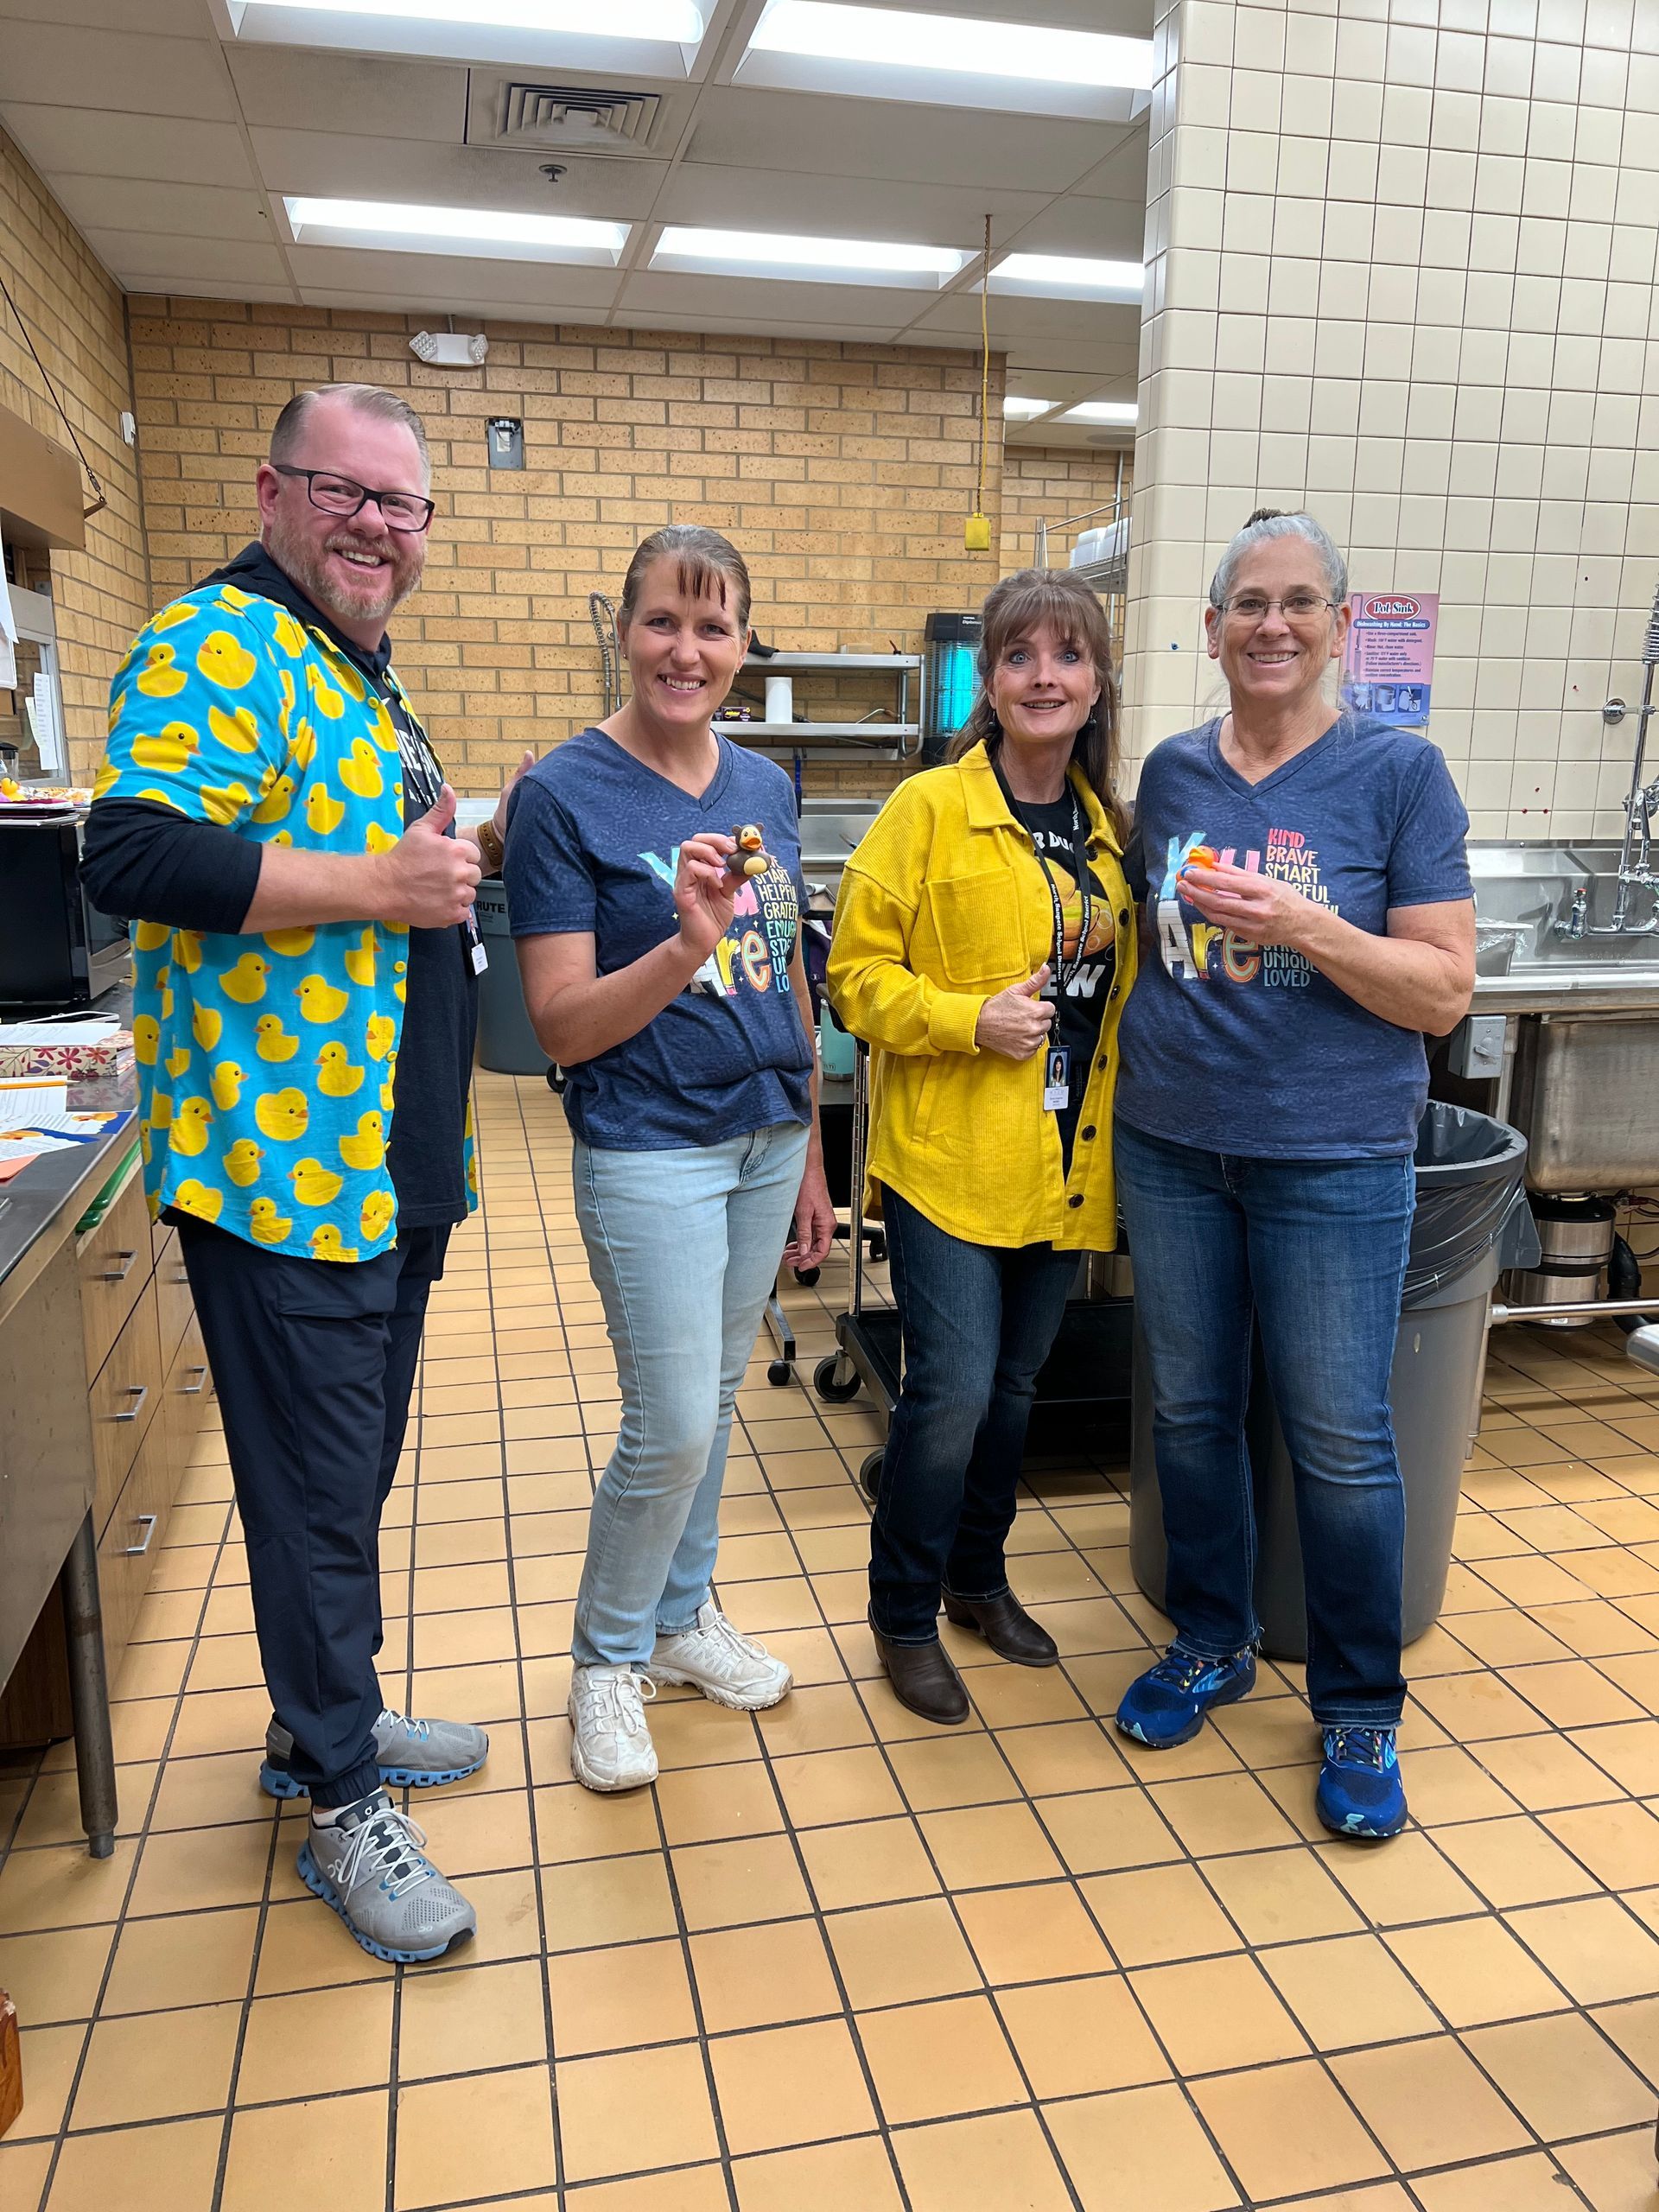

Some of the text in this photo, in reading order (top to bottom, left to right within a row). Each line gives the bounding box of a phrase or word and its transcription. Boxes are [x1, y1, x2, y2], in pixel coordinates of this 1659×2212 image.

[1374, 601, 1414, 614] Pot Sink
[1268, 827, 1306, 849] KIND
[1265, 844, 1319, 868] BRAVE
[1264, 861, 1322, 885] SMART
[757, 883, 798, 904] HELPFU
[476, 900, 505, 914] RUTE
[1263, 969, 1312, 988] LOVED
